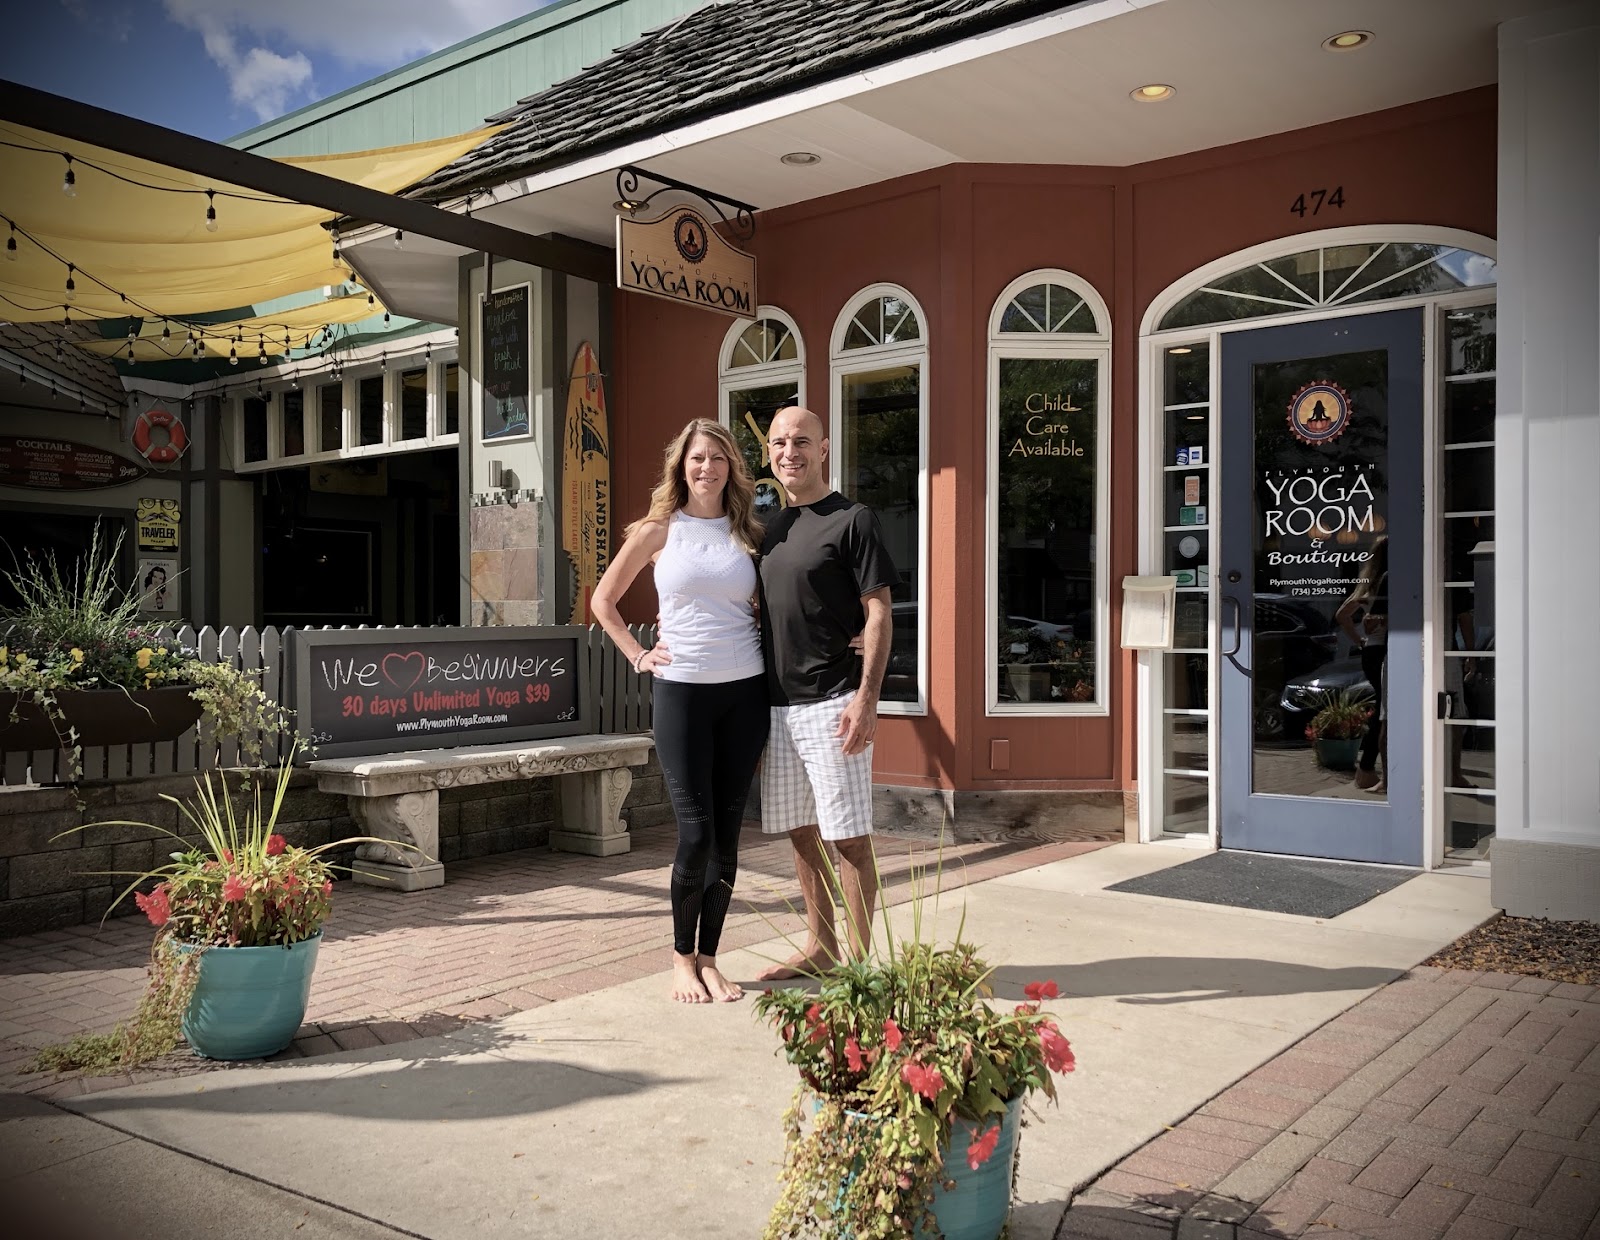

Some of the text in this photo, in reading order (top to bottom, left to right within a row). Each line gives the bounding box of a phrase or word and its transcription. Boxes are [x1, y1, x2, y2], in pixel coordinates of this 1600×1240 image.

[1290, 186, 1346, 218] 474
[630, 249, 748, 289] PLYMOUTH
[630, 260, 751, 312] YOGA ROOM
[1025, 392, 1082, 413] Child
[1025, 415, 1069, 436] Care
[16, 440, 72, 452] COCKTAILS
[1007, 438, 1084, 458] Available
[1265, 464, 1375, 477] PLYMOUTH
[1265, 473, 1374, 506] YOGA
[1265, 504, 1374, 537] ROOM
[141, 527, 176, 540] TRAVELER
[581, 510, 595, 555] Lager
[595, 479, 607, 586] LANDSHAR
[1310, 537, 1324, 549] &
[1267, 550, 1374, 568] Boutique
[1269, 577, 1370, 587] PlymouthYogaRoom.com
[1291, 587, 1347, 596] (734) 259-4324
[321, 653, 566, 691] We Beginners
[342, 683, 551, 718] 30 days Unlimited Yoga $39
[396, 713, 508, 732] www.PlymouthYogaRoom.com
